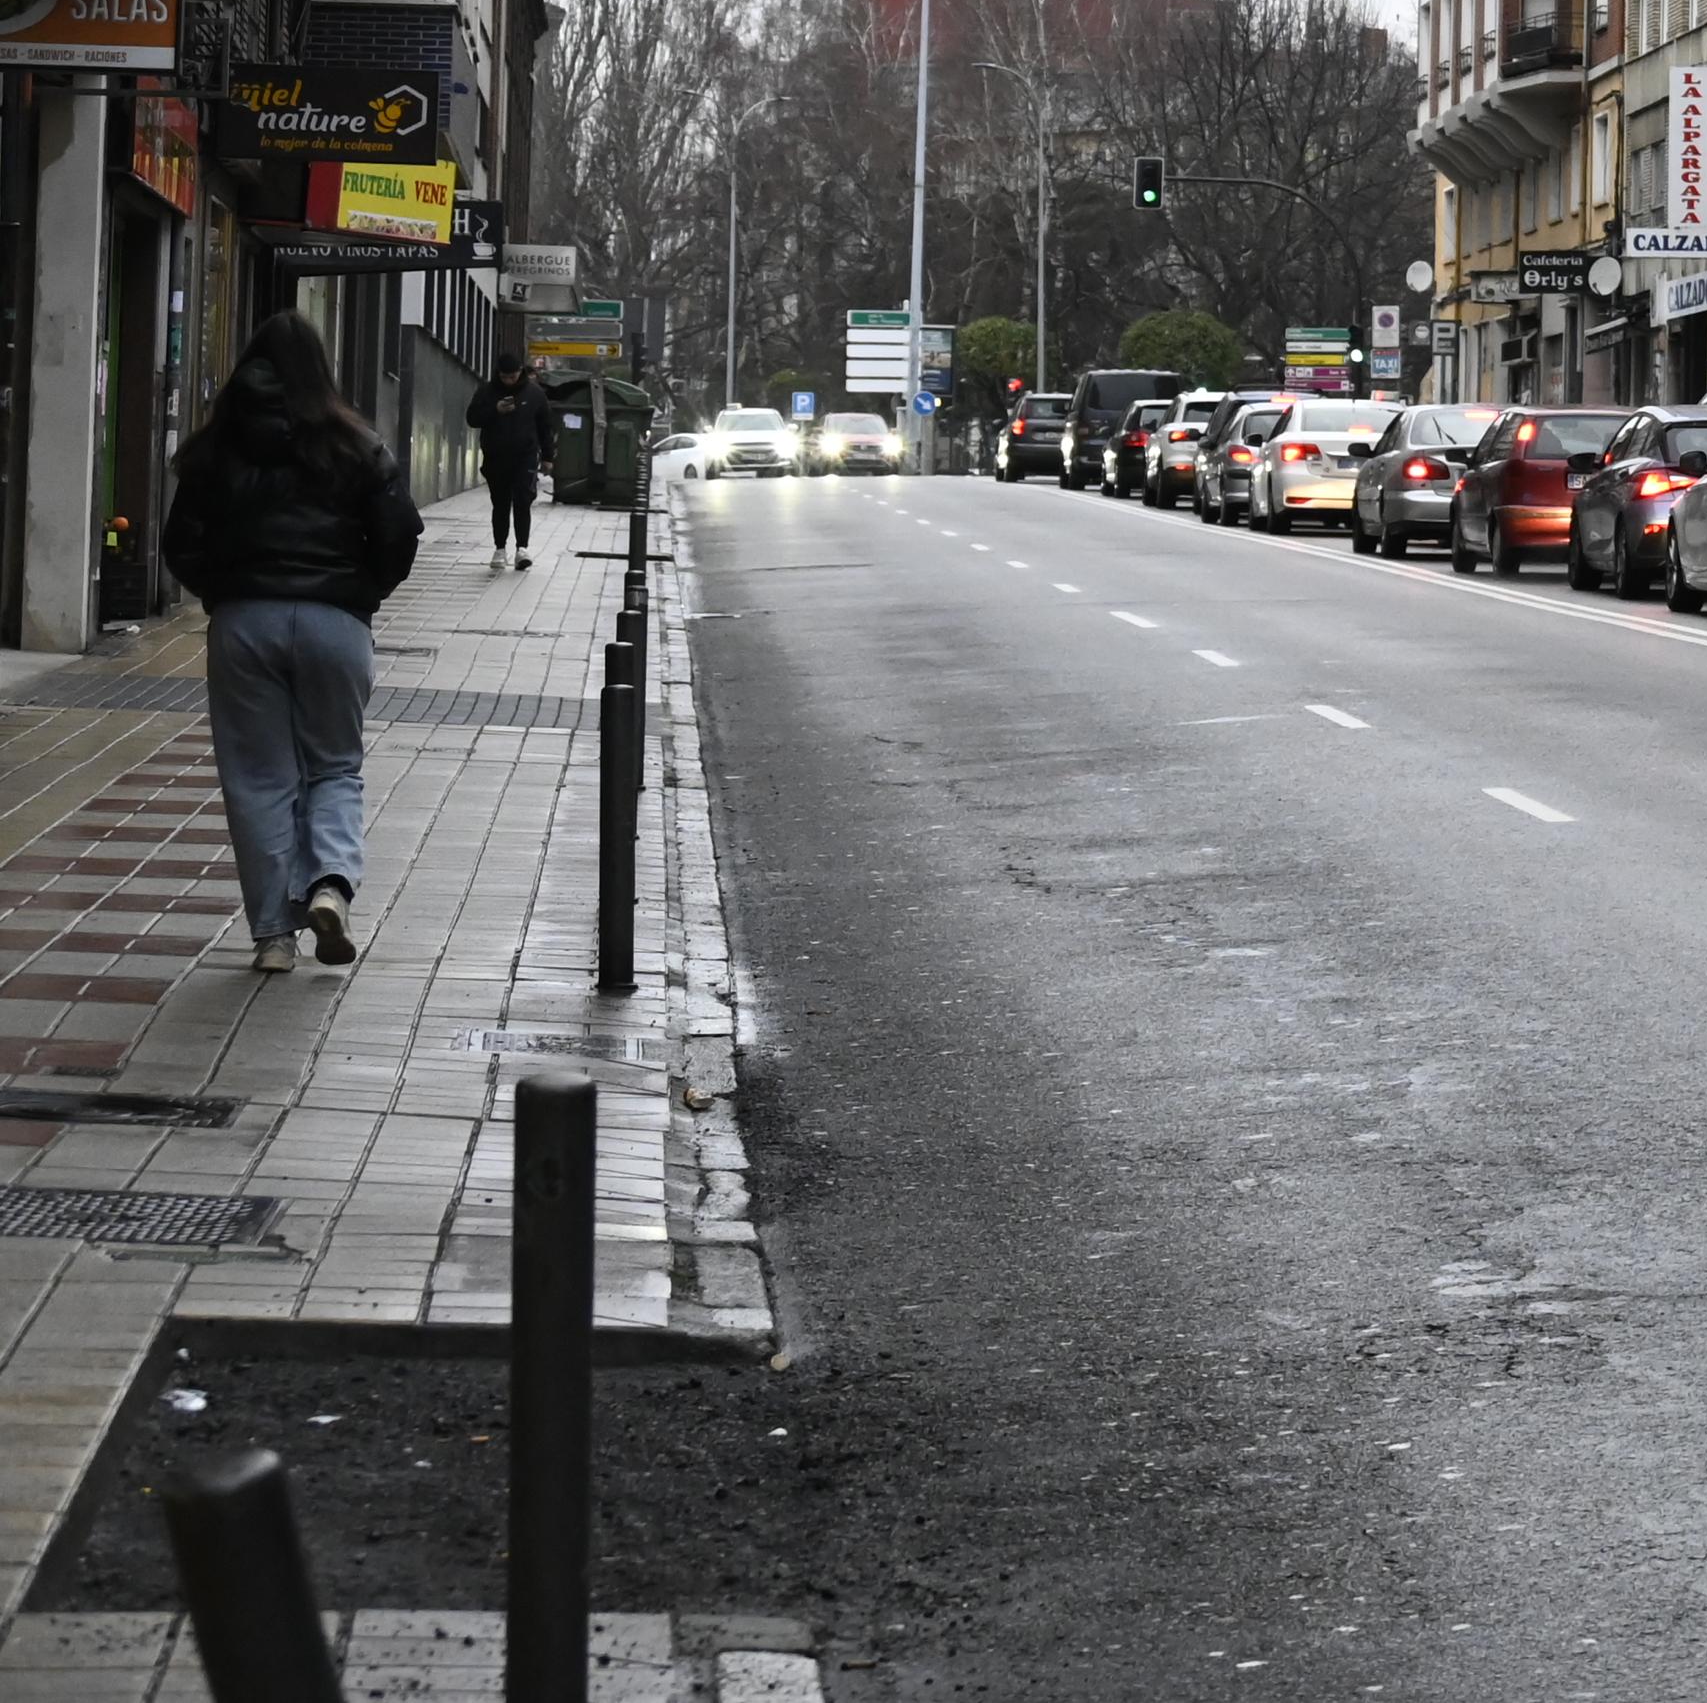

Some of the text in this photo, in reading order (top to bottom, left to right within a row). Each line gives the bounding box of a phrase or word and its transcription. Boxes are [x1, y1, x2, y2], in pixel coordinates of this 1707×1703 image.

[27, 48, 75, 62] SANDWICH
[84, 51, 127, 64] RACIONES
[257, 102, 366, 133] nature
[312, 137, 326, 149] de
[329, 138, 341, 149] la
[344, 139, 393, 152] colmena
[1681, 73, 1702, 223] LA ALPARGATA
[343, 171, 448, 206] FRUTERÍA VENE
[506, 254, 571, 266] ALBERGUE
[1524, 270, 1584, 290] Orly's
[1374, 359, 1397, 370] TAXI
[797, 395, 810, 411] P
